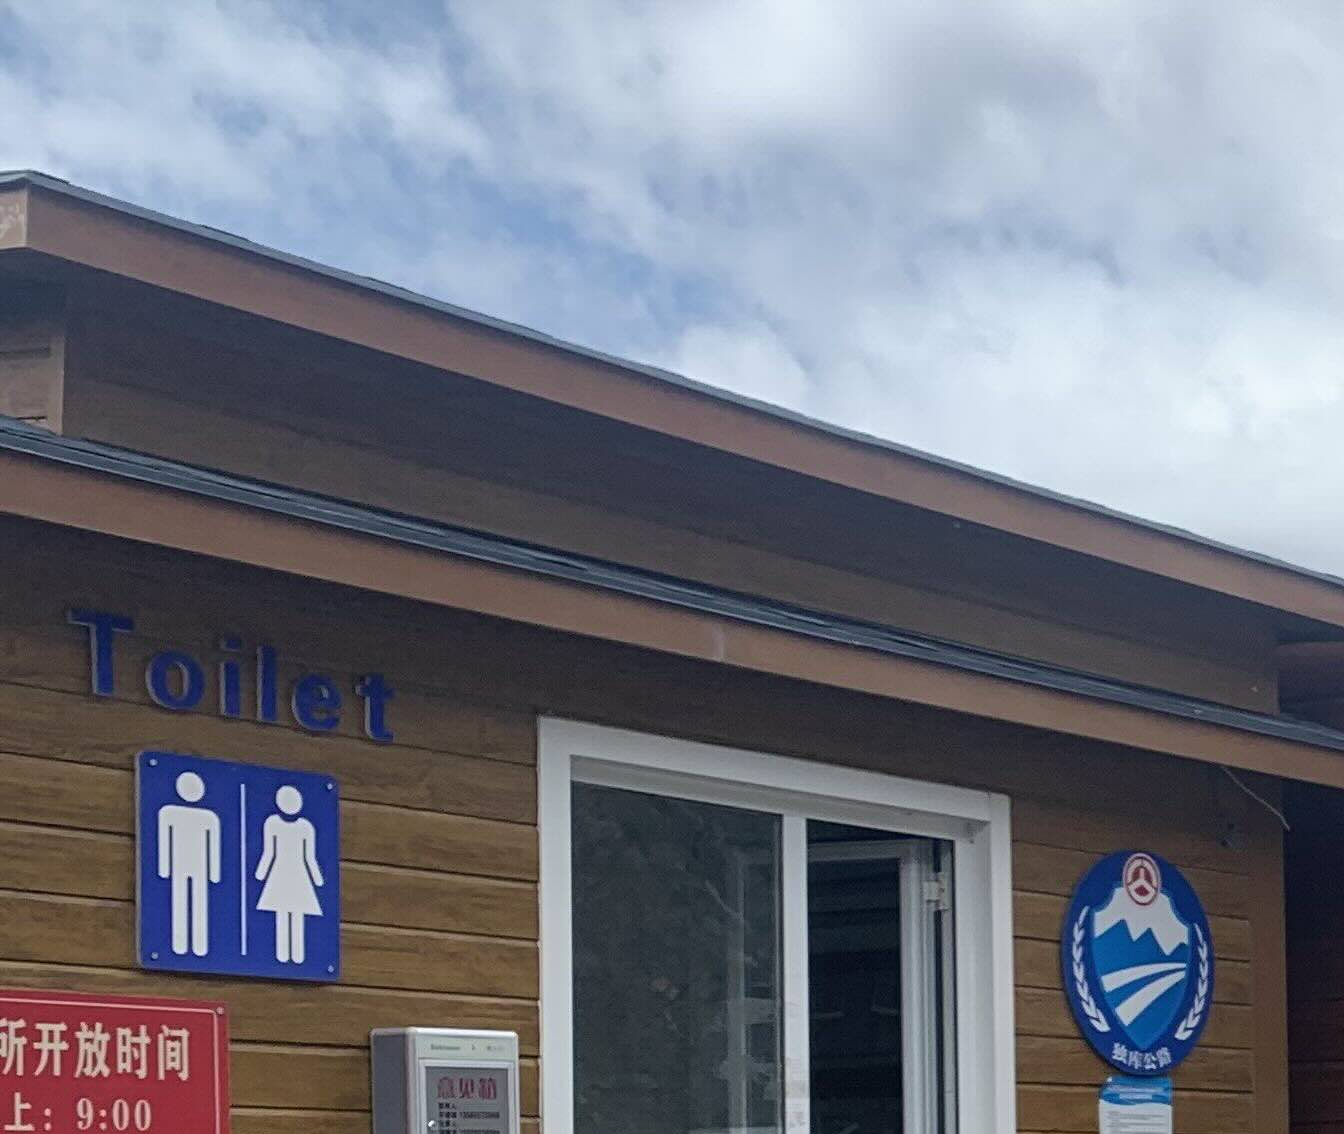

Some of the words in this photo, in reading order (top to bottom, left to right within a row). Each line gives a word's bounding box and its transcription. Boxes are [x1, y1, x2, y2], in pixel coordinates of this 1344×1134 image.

[66, 607, 396, 742] Toilet
[0, 1017, 190, 1081] 所开放时间
[76, 1098, 151, 1131] 9:00
